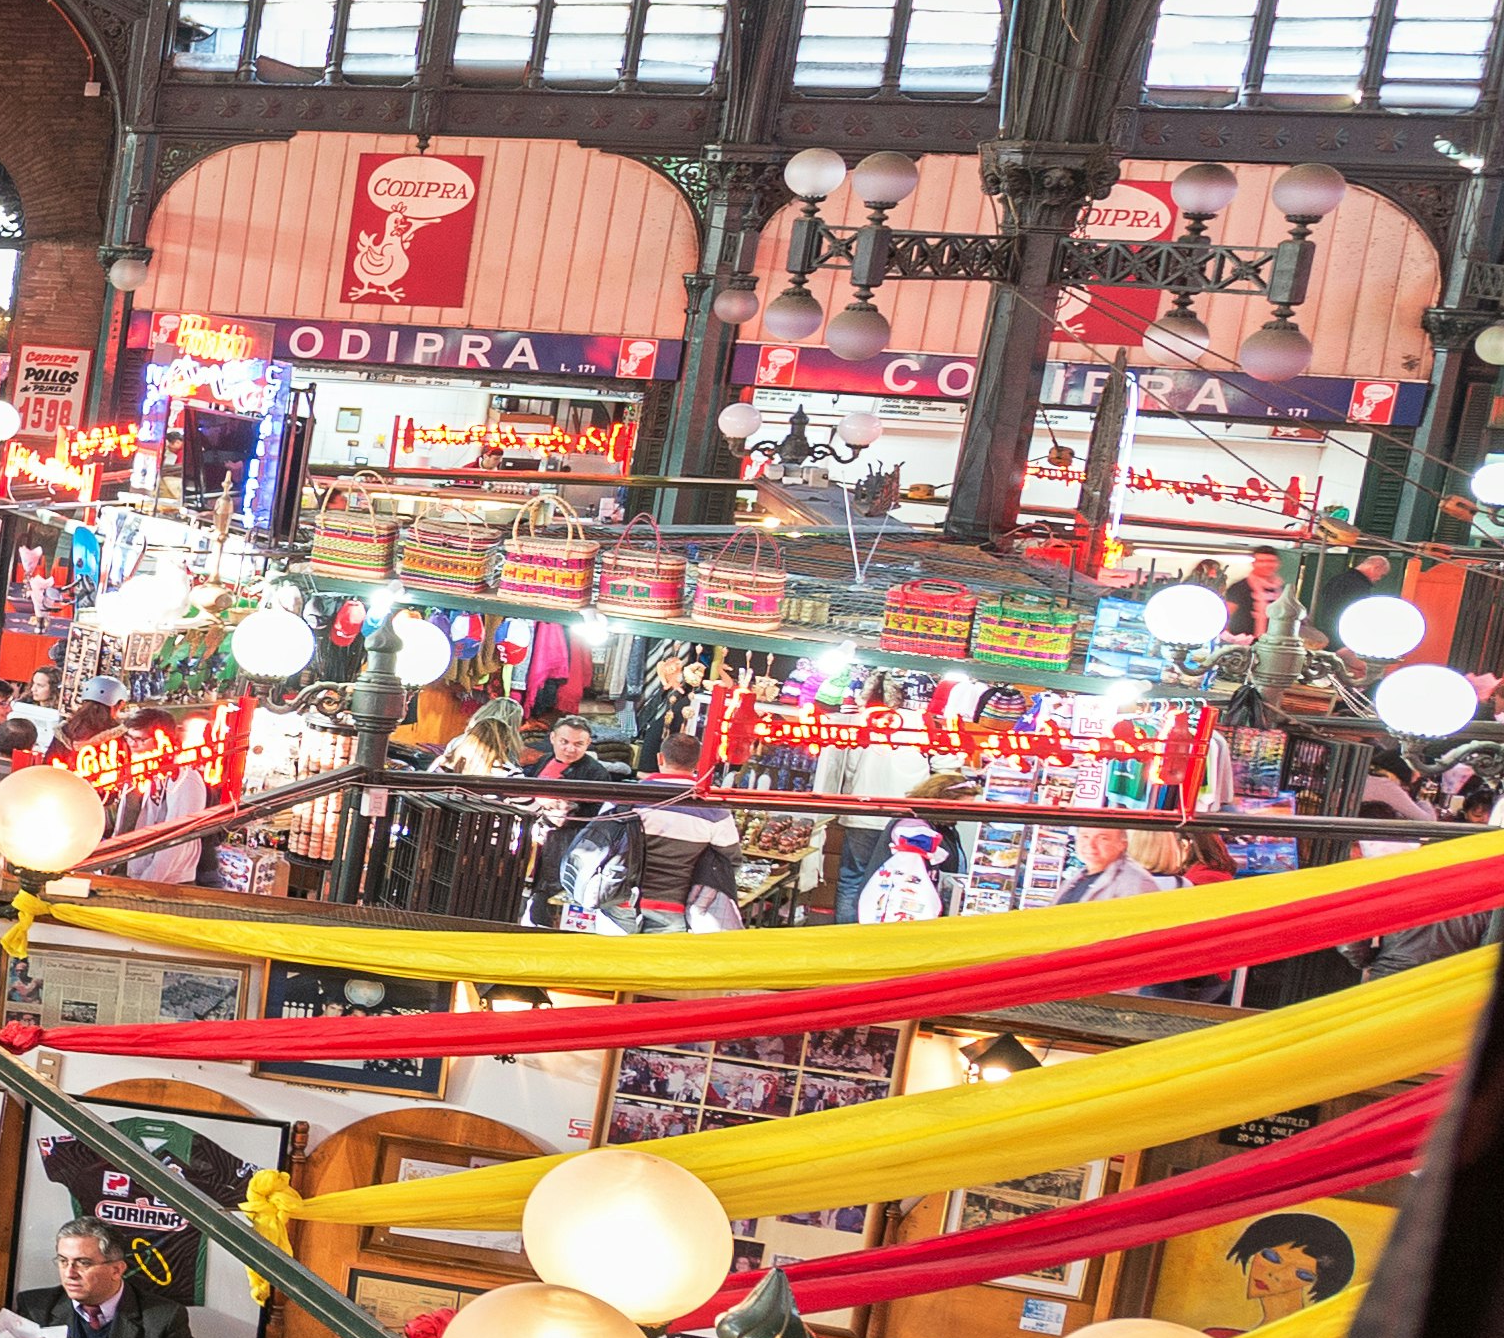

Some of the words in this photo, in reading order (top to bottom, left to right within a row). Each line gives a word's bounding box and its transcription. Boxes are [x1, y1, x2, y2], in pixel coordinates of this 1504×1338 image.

[373, 177, 469, 201] CODIPRA
[24, 367, 79, 384] POLLOS
[19, 396, 73, 433] 1598
